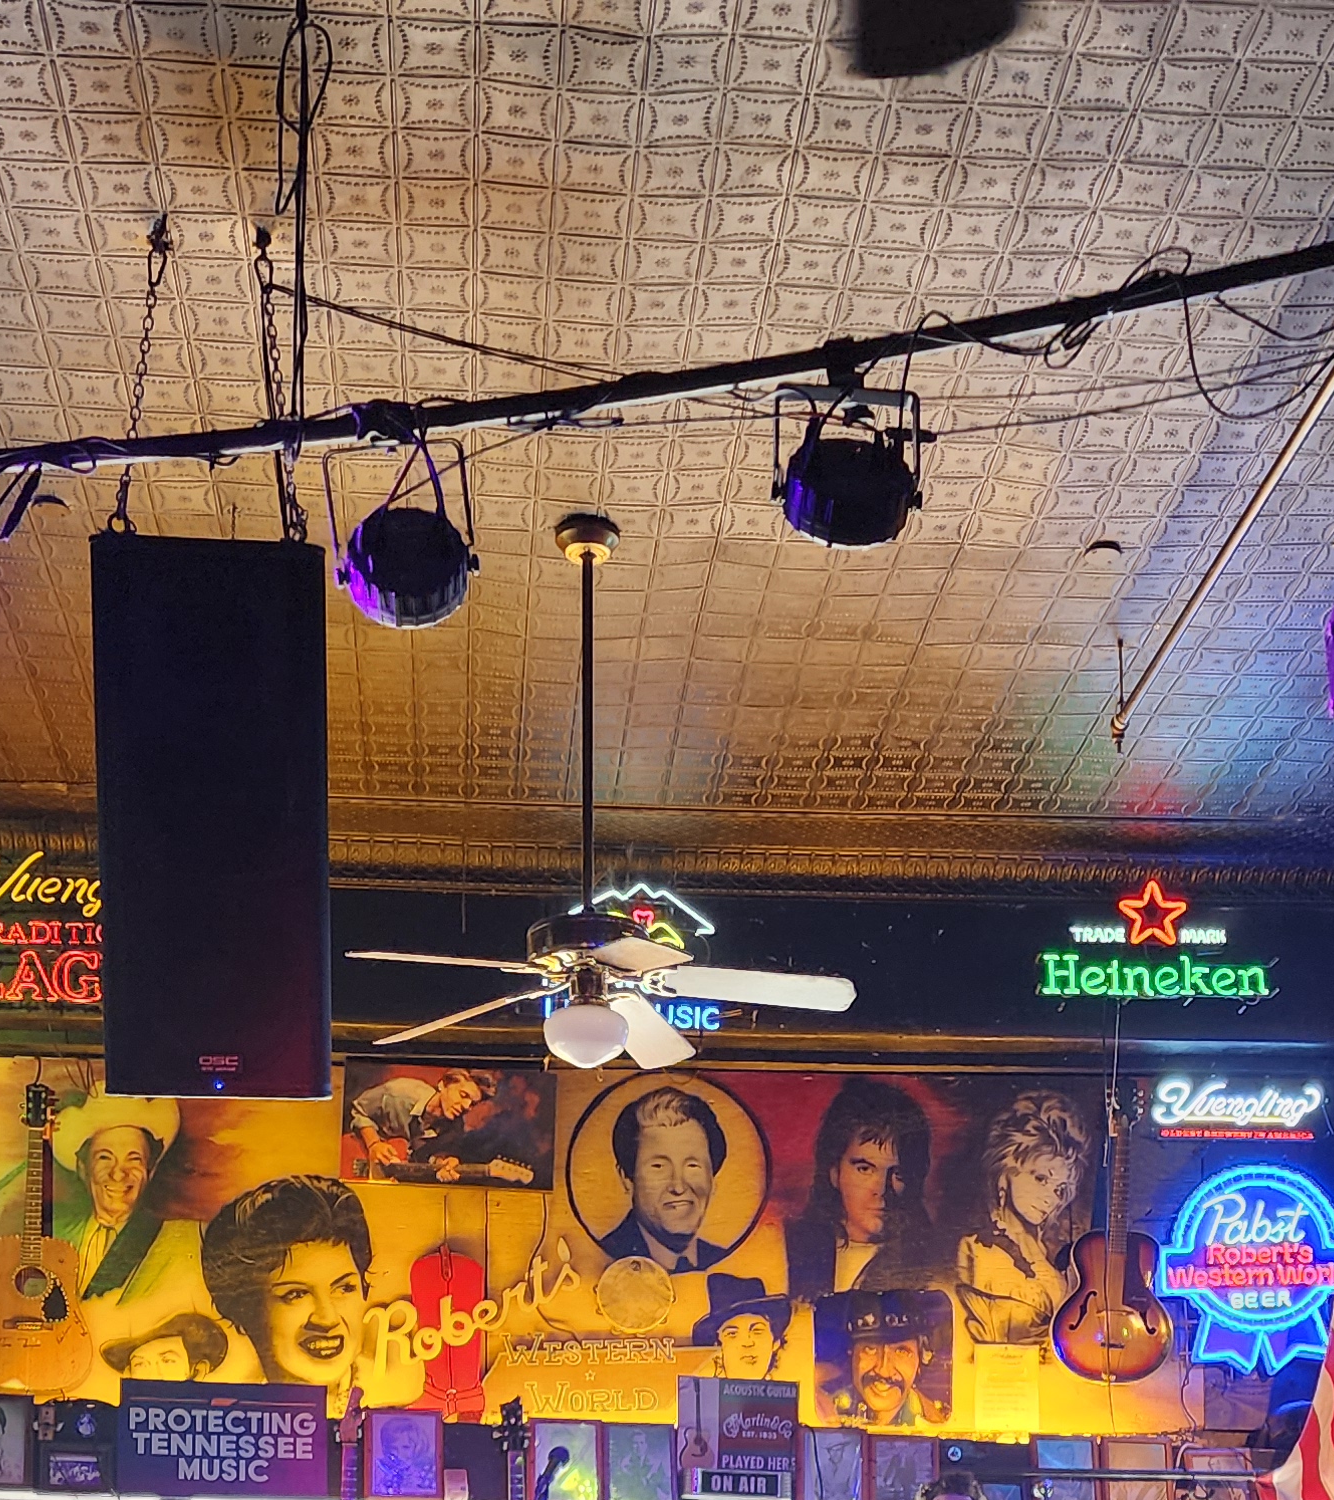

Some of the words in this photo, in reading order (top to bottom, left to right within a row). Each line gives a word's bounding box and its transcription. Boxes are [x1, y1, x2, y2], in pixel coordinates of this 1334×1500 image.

[1069, 926, 1126, 944] TRADE
[1180, 927, 1227, 945] MARK
[1041, 953, 1269, 997] Heineken
[1152, 1080, 1322, 1127] Yuengling
[1202, 1193, 1310, 1247] Pabst
[1206, 1242, 1314, 1267] Robert's
[1168, 1264, 1274, 1288] Western
[363, 1236, 582, 1377] Robert's
[1229, 1289, 1292, 1310] BEER
[502, 1332, 677, 1367] WESTERN
[524, 1381, 660, 1414] WORLD
[723, 1383, 765, 1398] ACOUSTIC
[766, 1385, 797, 1399] GUITAR
[128, 1406, 317, 1436] PROTECTING
[132, 1431, 313, 1460] TENNESSEE
[177, 1457, 269, 1482] MUSIC
[721, 1454, 765, 1469] PLAYED
[710, 1474, 733, 1493] ON
[738, 1475, 767, 1494] AIR
